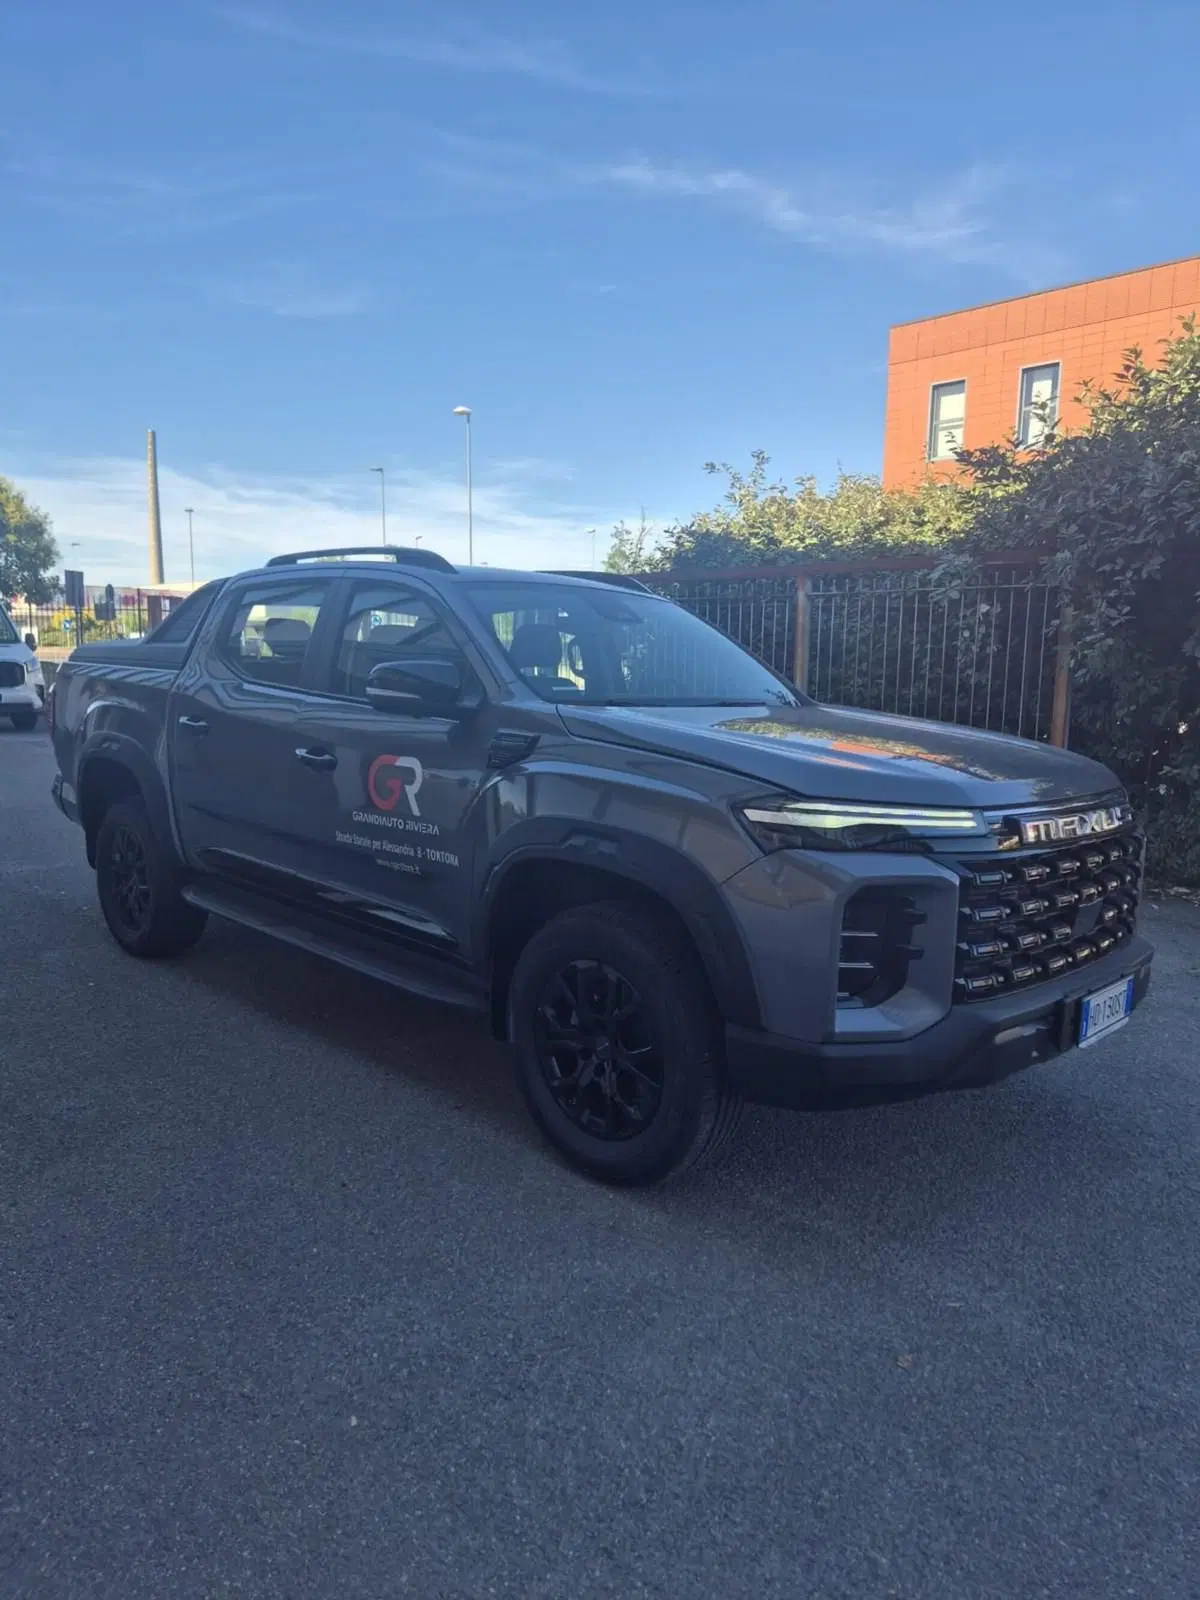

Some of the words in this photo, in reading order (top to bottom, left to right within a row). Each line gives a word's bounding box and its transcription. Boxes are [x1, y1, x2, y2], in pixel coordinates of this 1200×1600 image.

[368, 754, 423, 816] GR
[352, 811, 404, 830] GRANDIAUTO
[405, 819, 440, 836] RIVIERA
[426, 848, 459, 868] TORTONA
